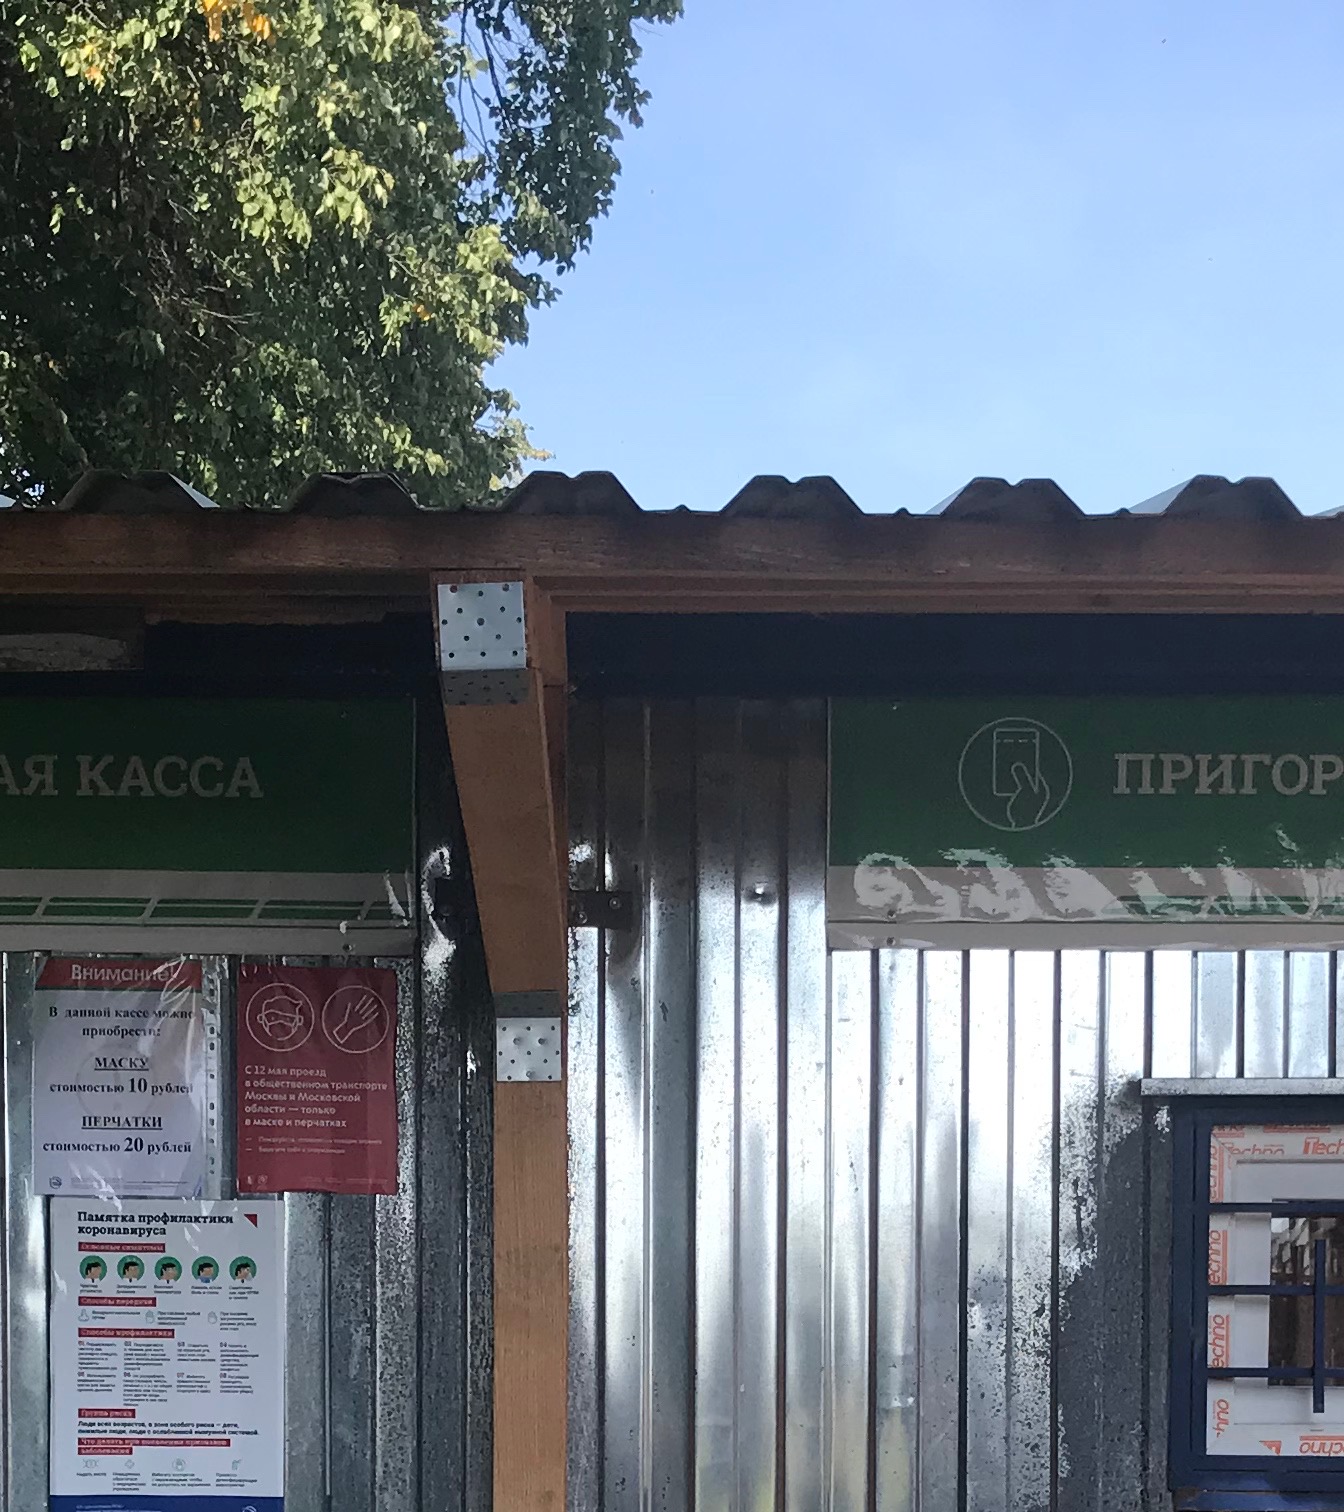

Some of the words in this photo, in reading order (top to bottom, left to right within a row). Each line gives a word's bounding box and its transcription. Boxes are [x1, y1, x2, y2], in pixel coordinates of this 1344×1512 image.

[76, 755, 263, 798] КАССА
[71, 964, 174, 981] Внимание!
[49, 1006, 58, 1018] В
[65, 1006, 111, 1019] данной
[116, 1010, 149, 1018] кассе
[82, 1026, 161, 1039] приобрести:
[95, 1057, 149, 1070] МАСКУ
[245, 1065, 252, 1075] С
[254, 1065, 266, 1075] 12
[290, 1068, 327, 1078] проезд
[50, 1083, 124, 1093] стоимостью
[128, 1078, 148, 1094] 10
[253, 1078, 329, 1089] общественном
[331, 1081, 387, 1091] транспорте
[245, 1091, 287, 1100] Москвы
[297, 1091, 361, 1102] Московской
[245, 1104, 286, 1113] области
[301, 1106, 336, 1115] только
[81, 1116, 163, 1130] ПЕРЧАТКИ
[295, 1120, 347, 1128] перчатках
[43, 1142, 121, 1152] стоимостью
[124, 1137, 144, 1153] 20
[147, 1142, 191, 1155] рублей
[77, 1211, 135, 1223] Памятка
[138, 1212, 234, 1225] профилактики
[77, 1225, 166, 1238] коронавируса
